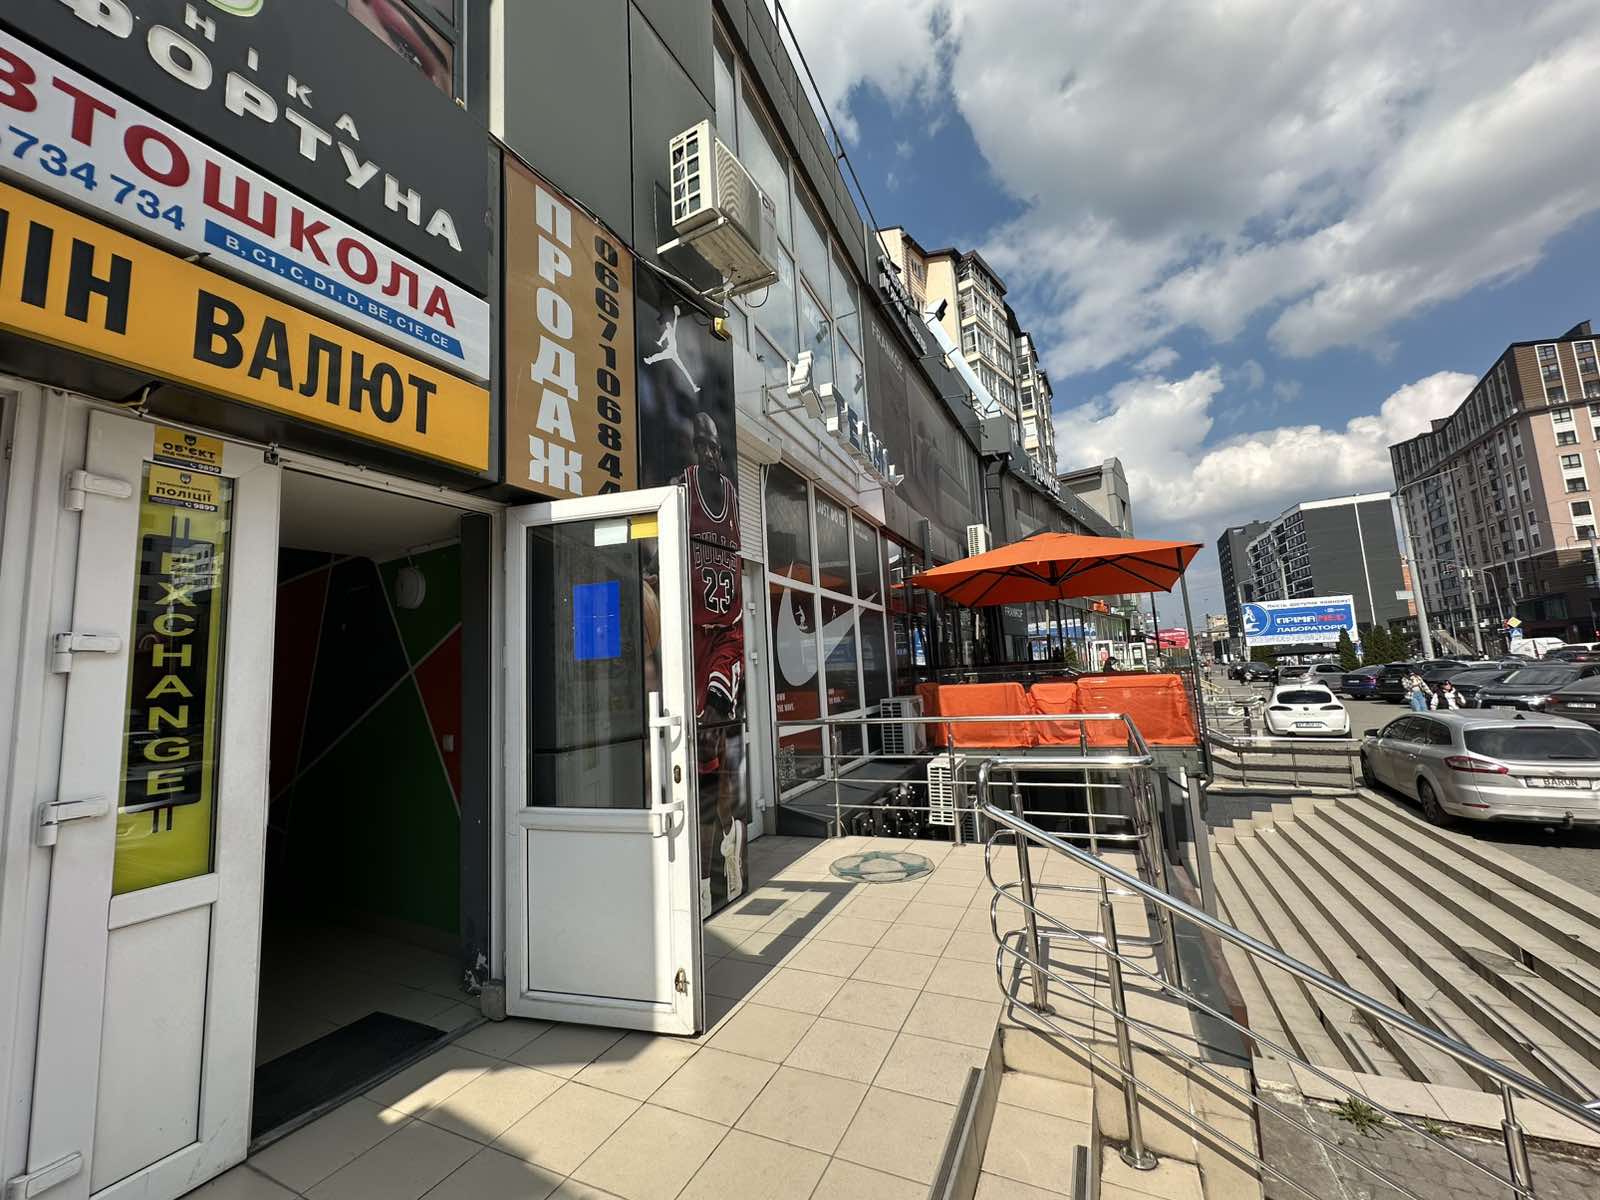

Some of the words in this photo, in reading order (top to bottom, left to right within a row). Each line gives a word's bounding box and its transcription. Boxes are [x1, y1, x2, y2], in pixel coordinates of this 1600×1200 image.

[8, 125, 98, 191] 734
[110, 174, 185, 231] 734
[0, 207, 133, 336] ІН
[193, 288, 437, 434] ВАЛЮТ
[431, 332, 449, 349] CE
[528, 184, 583, 496] ПРОДАЖ
[702, 567, 735, 614] 23
[144, 551, 197, 797] EXCHANGE
[1543, 778, 1577, 787] BARON
